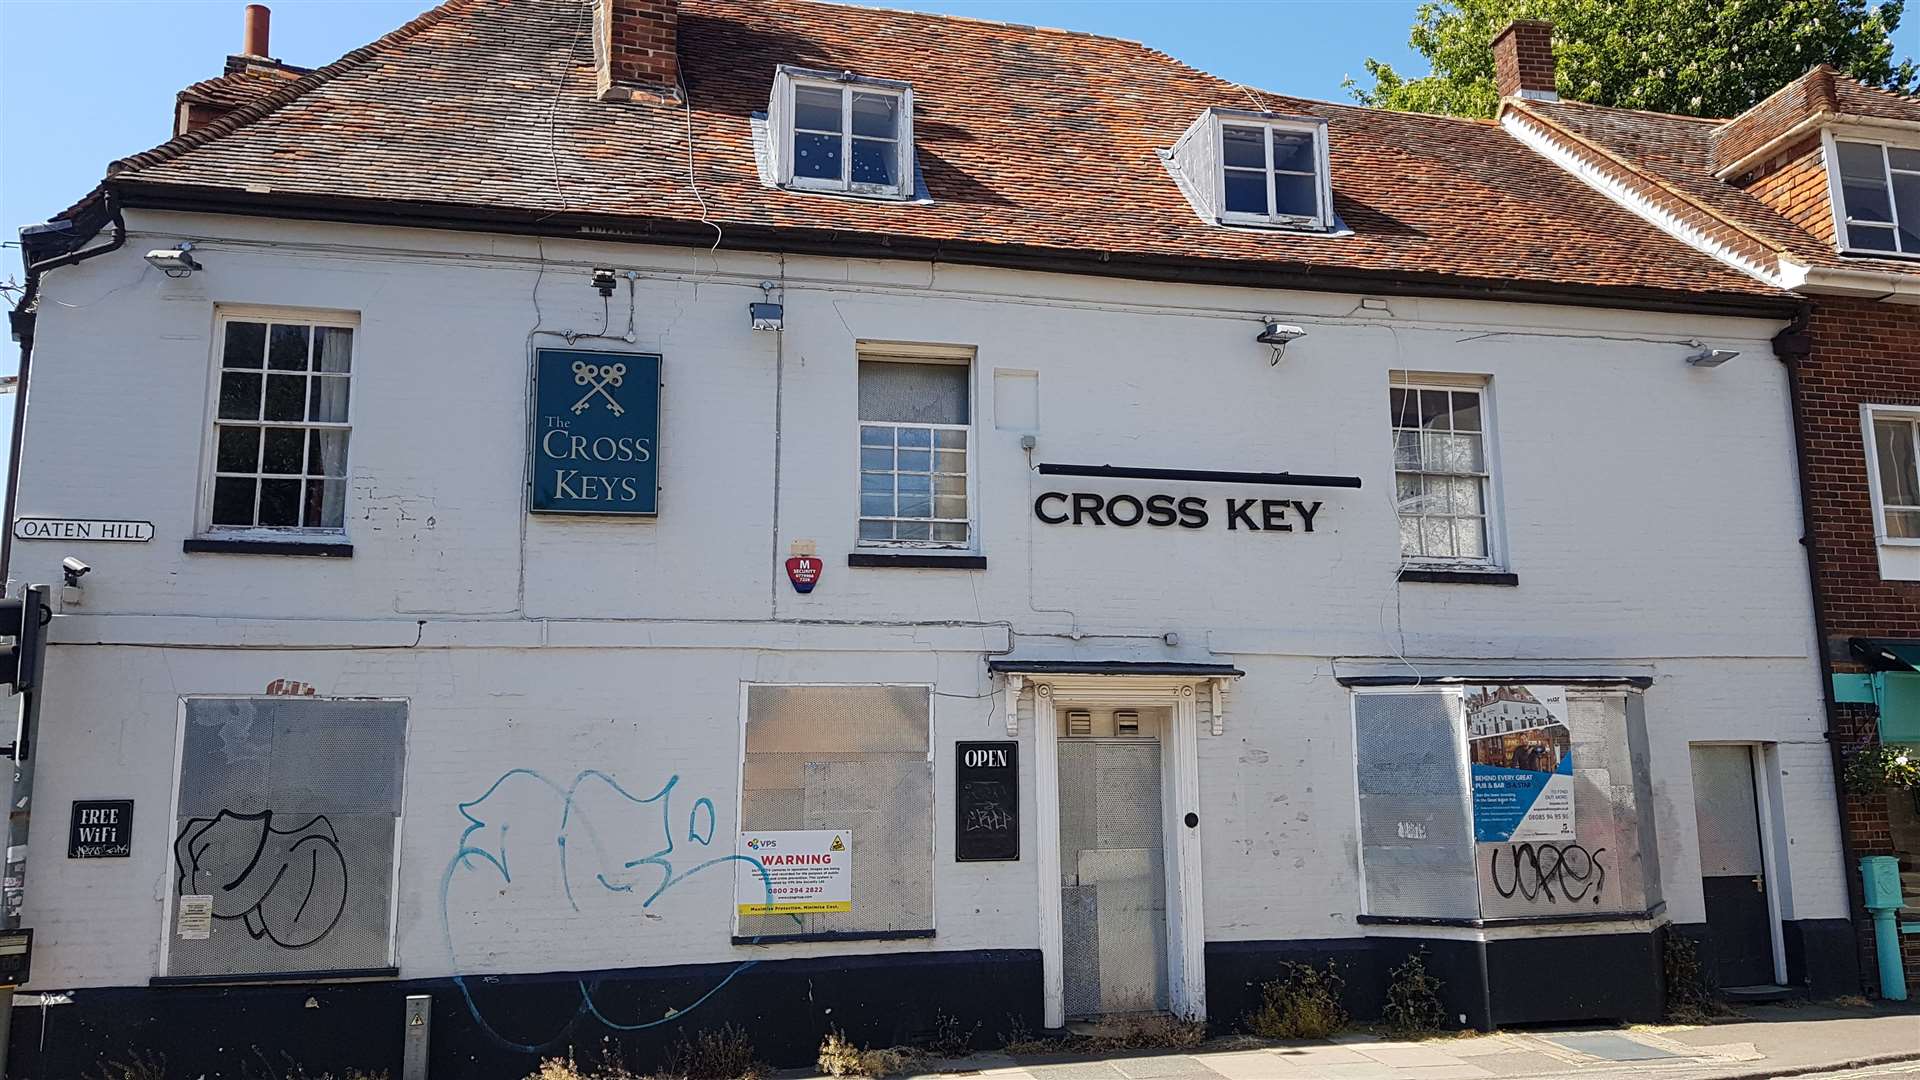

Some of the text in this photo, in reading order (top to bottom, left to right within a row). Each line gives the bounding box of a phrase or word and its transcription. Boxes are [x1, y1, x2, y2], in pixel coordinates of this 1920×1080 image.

[545, 416, 571, 428] The
[543, 429, 650, 462] CROSS
[553, 469, 637, 501] KEYS
[1034, 492, 1323, 532] CROSS KEY
[24, 521, 145, 539] OATEN HILL
[800, 560, 810, 569] M
[964, 749, 1008, 767] OPEN
[80, 808, 119, 825] FREE
[79, 827, 117, 842] WiFi
[760, 840, 777, 848] VPS
[761, 854, 832, 866] WARNING
